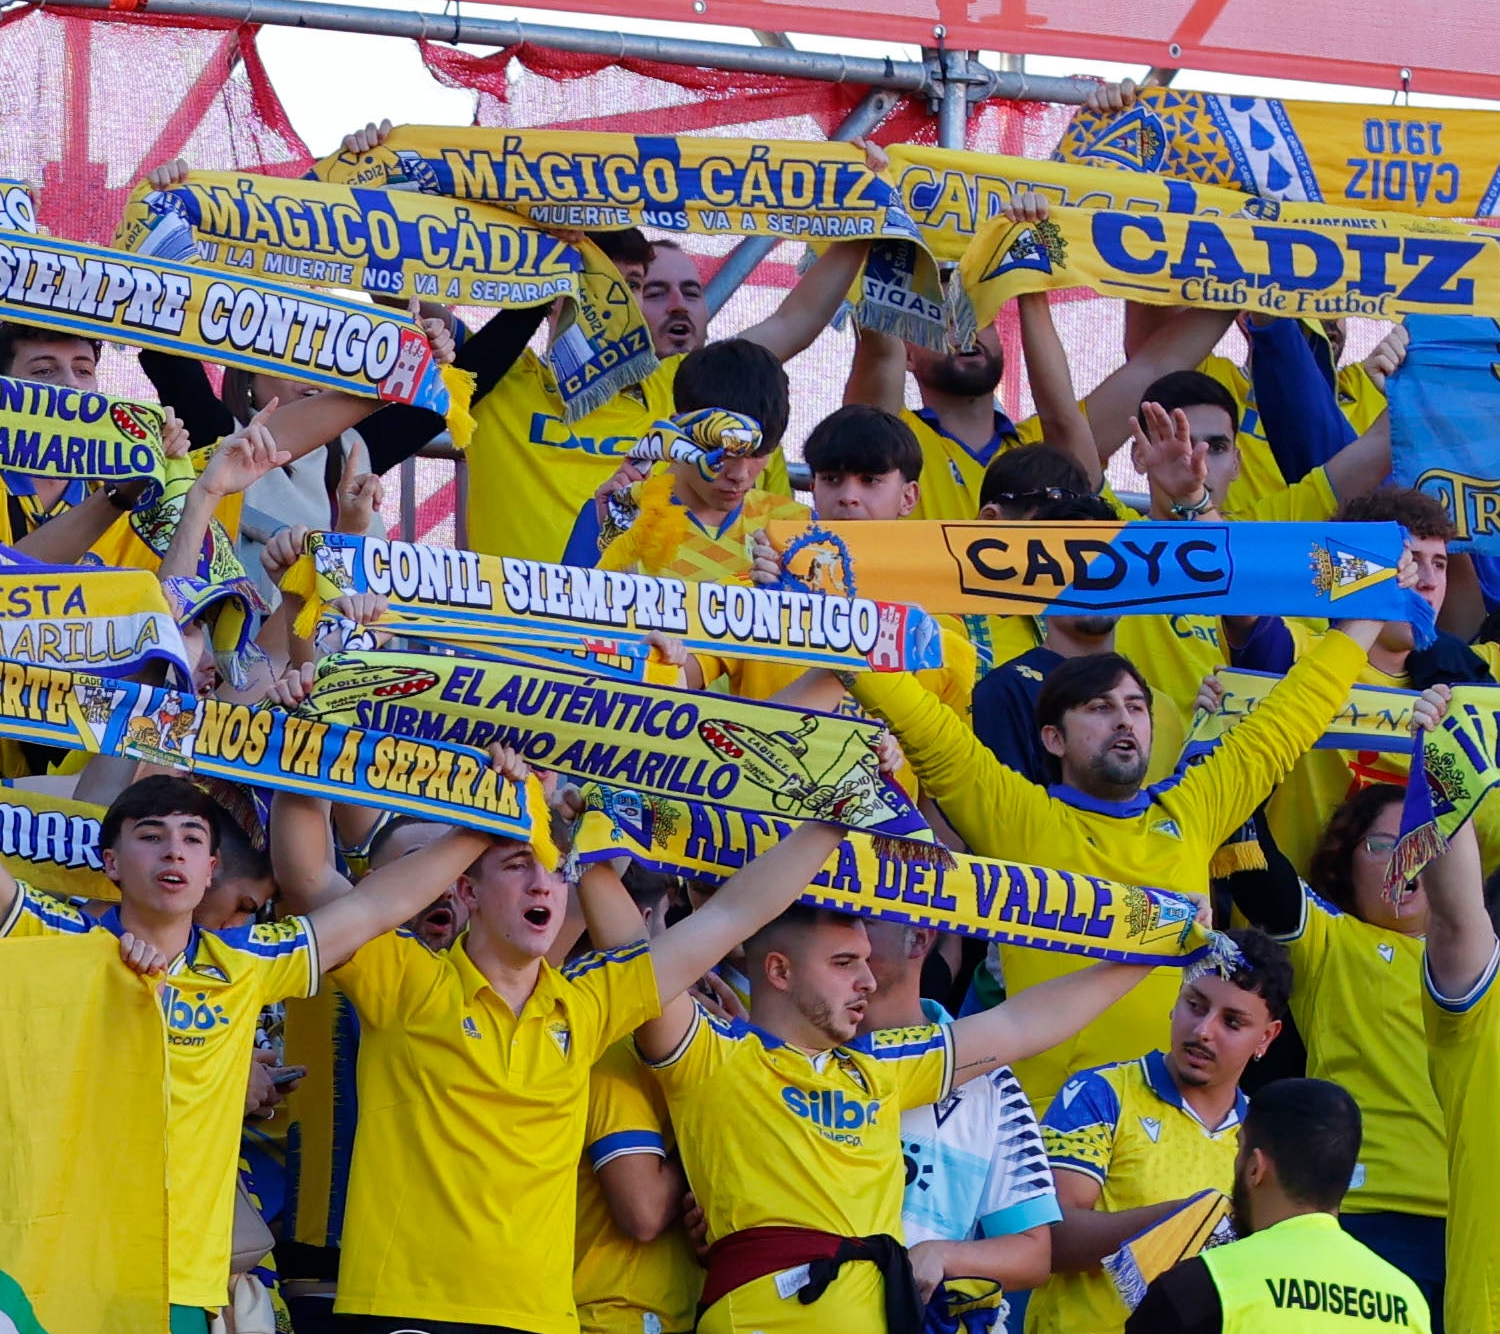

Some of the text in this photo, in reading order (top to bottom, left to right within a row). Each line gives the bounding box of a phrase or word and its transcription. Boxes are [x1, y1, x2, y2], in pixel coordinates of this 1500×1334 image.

[1364, 118, 1442, 156] 1910
[442, 136, 683, 203] MÁGICO
[698, 145, 881, 210] CÁDIZ
[1345, 158, 1461, 208] CÁDIZ
[197, 178, 573, 275] MÁGICO CÁDIZ
[529, 203, 875, 237] MUERTE NOS VA A SEPARAR
[224, 247, 572, 302] LA MUERTE NOS VA A SEPARAR
[1092, 212, 1484, 305] CADIZ
[1181, 278, 1393, 315] Club de Fútbol
[199, 280, 400, 384] CONTIGO
[564, 330, 650, 393] CÁDIZ
[963, 537, 1230, 589] CADYC
[361, 537, 880, 653] CONIL SIEMPRE CONTIGO
[440, 666, 700, 741] EL AUTÉNTICO
[196, 699, 271, 769] NOS
[280, 717, 330, 771] VA
[337, 735, 358, 773] A
[552, 737, 739, 800] AMARILLO
[874, 846, 1117, 939] DEL VALLE
[1266, 1275, 1409, 1328] VADISEGUR
